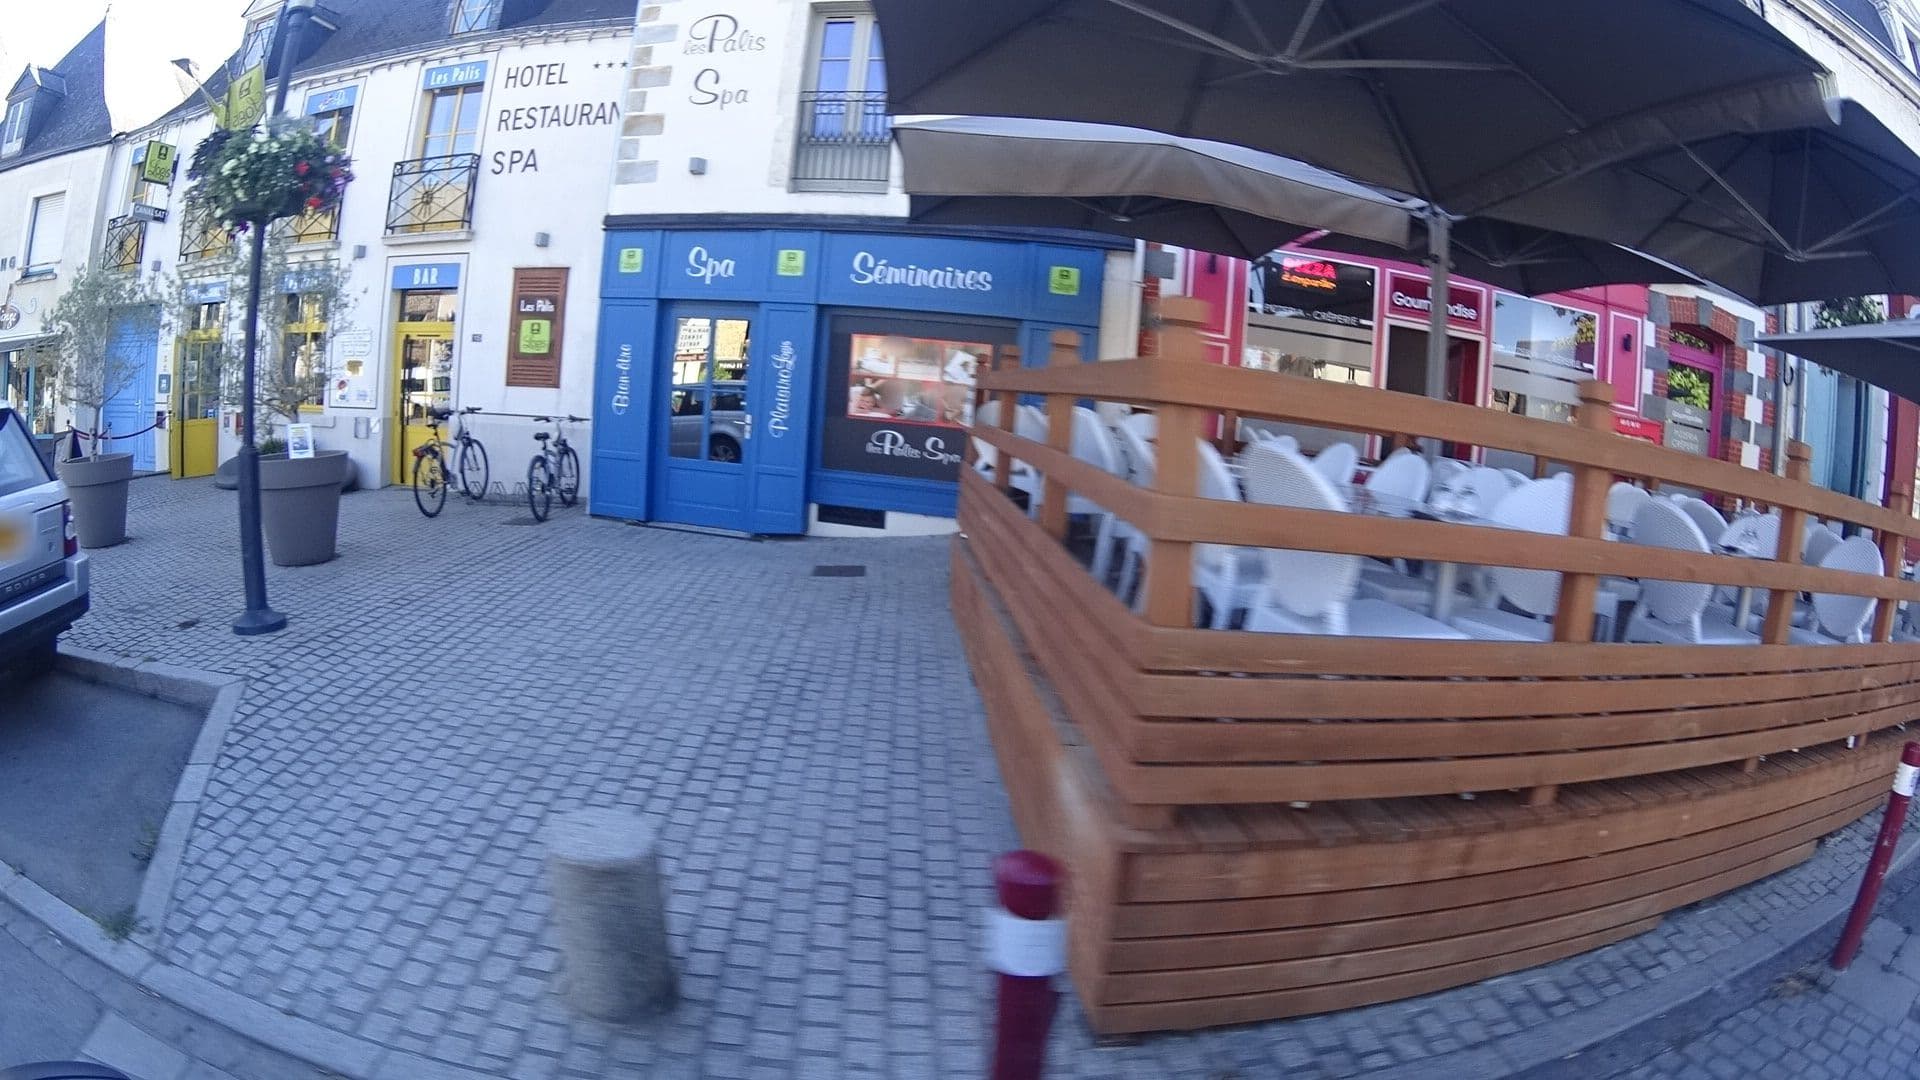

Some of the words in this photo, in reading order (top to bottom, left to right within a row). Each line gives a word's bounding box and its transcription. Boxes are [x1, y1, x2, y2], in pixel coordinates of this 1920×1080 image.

[689, 13, 766, 54] Palis
[430, 70, 449, 86] Les
[451, 64, 481, 83] Palis
[504, 62, 569, 89] HOTEL
[688, 67, 749, 111] Spa
[491, 148, 538, 176] SPA
[413, 267, 439, 285] BAR
[685, 246, 736, 285] Spa
[849, 251, 993, 292] Séminaires
[520, 299, 535, 312] Les
[870, 429, 921, 459] Palis
[922, 436, 961, 466] Spa
